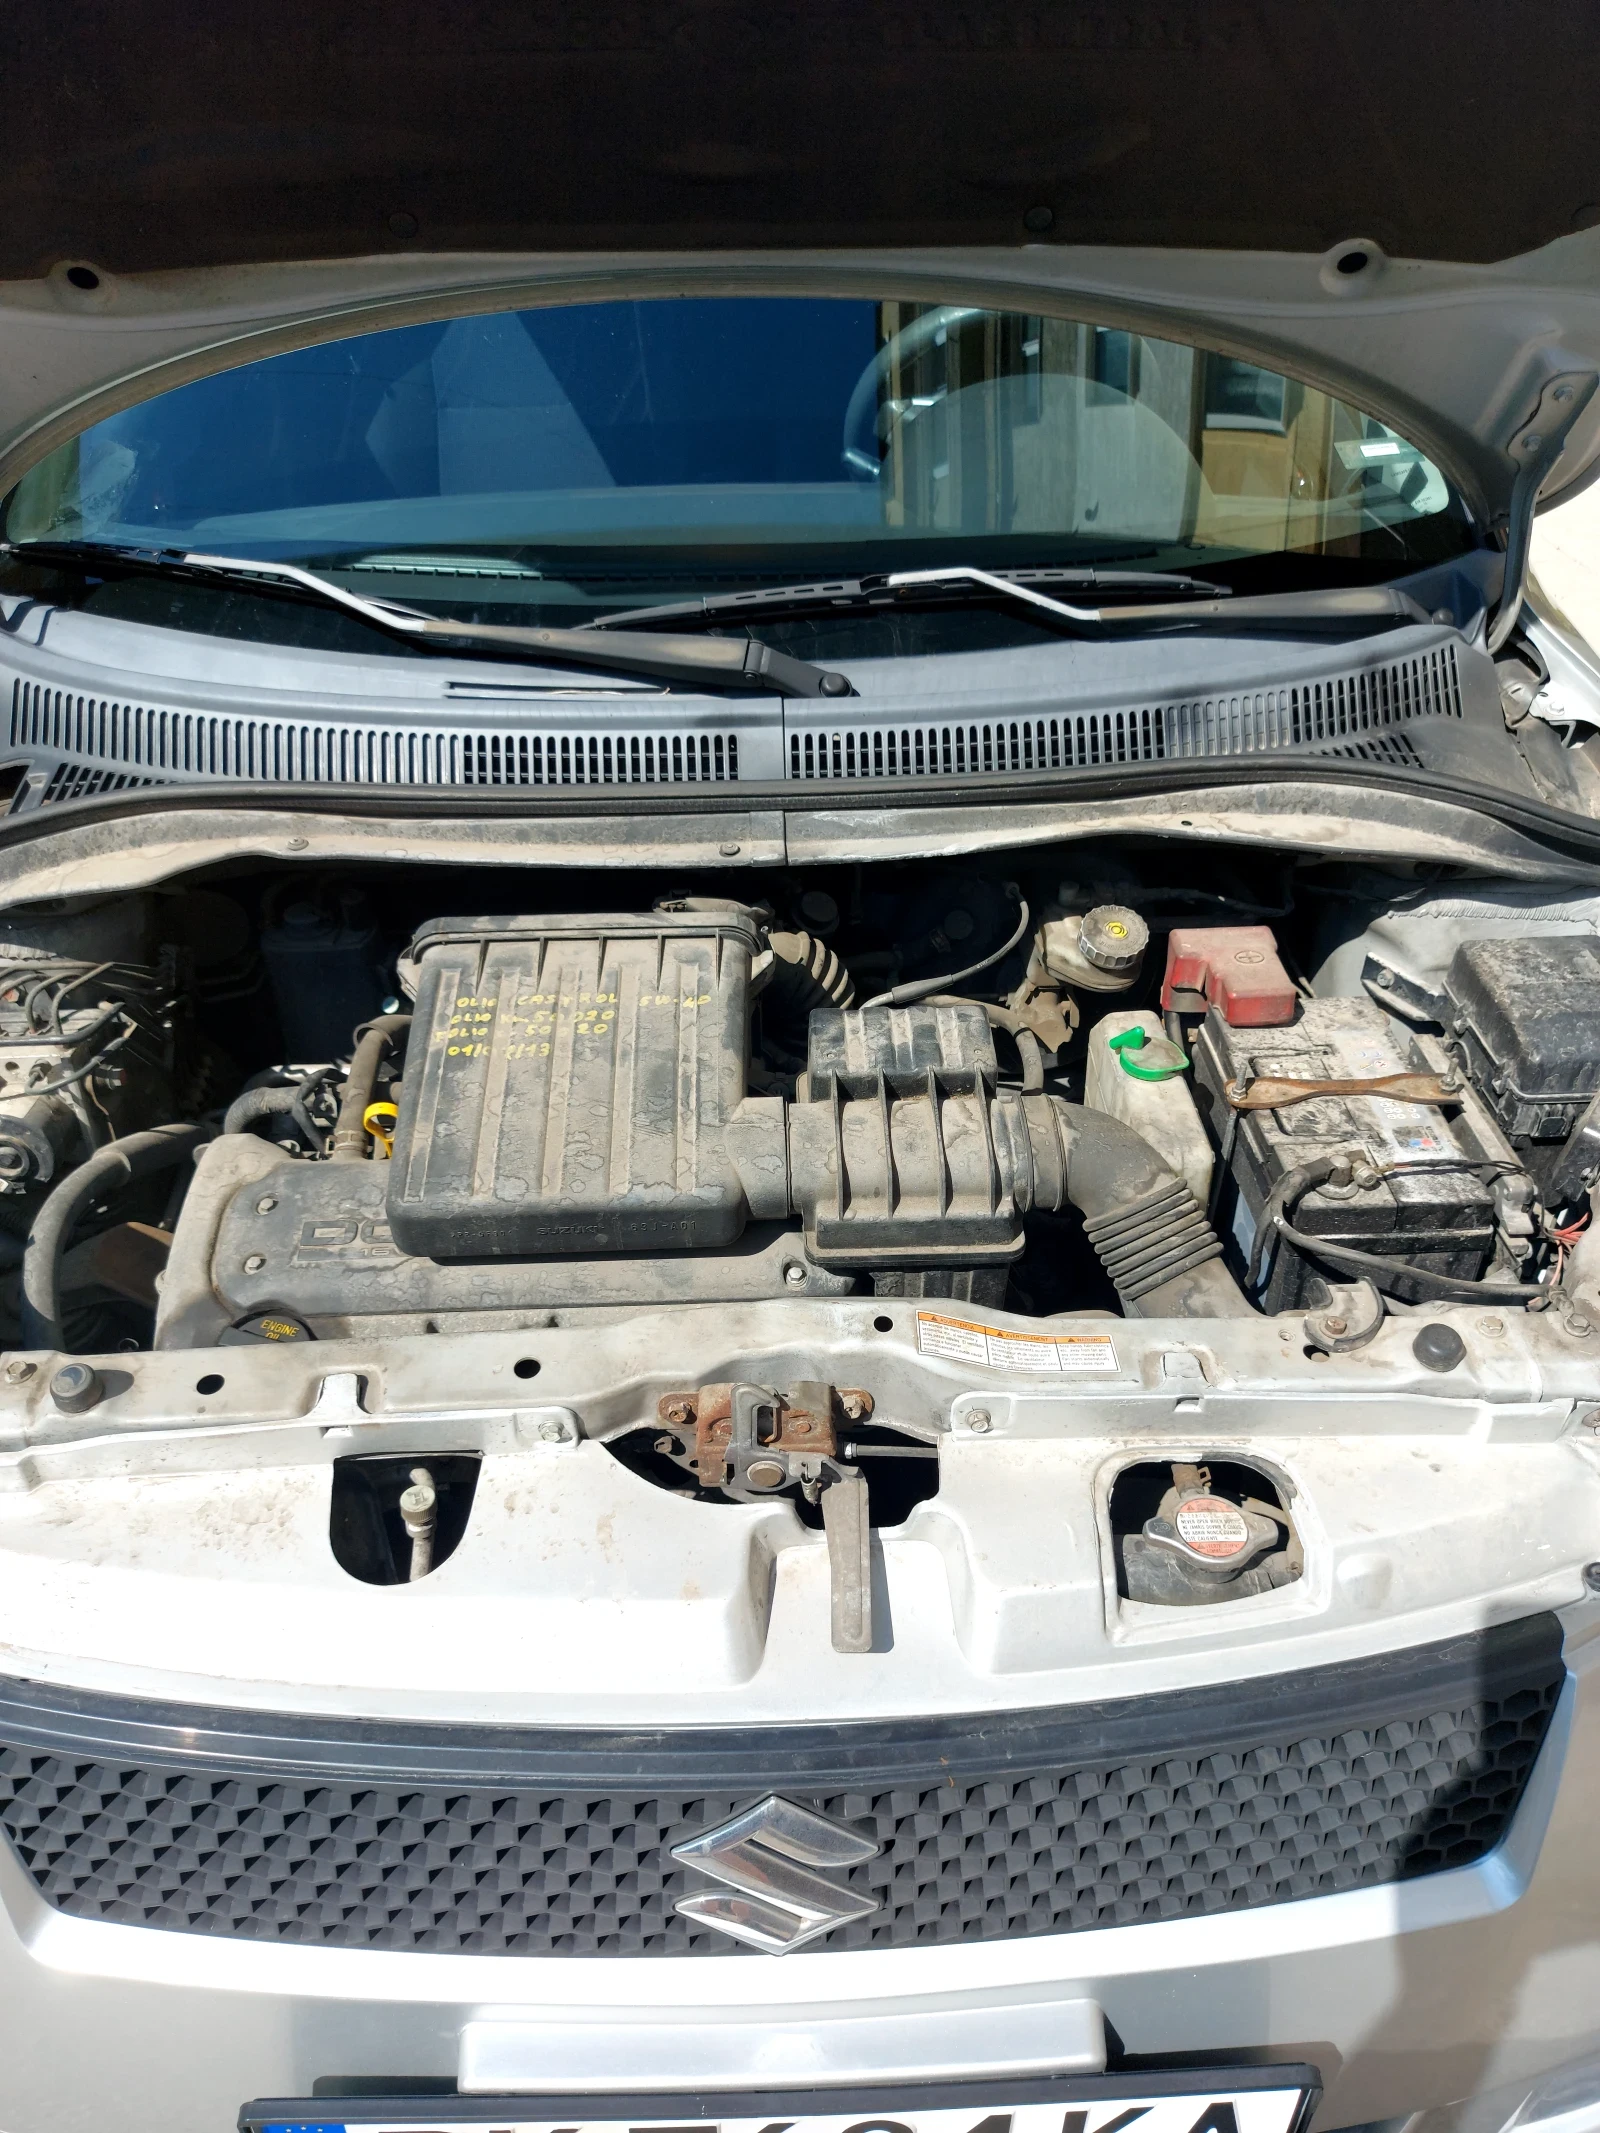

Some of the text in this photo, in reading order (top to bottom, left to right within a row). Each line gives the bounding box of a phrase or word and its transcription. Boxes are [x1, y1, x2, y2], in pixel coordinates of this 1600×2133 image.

[456, 997, 497, 1009] OLIO
[517, 994, 618, 1008] CASTROL
[536, 1223, 605, 1236] SUZUKI
[260, 1318, 300, 1337] ENGINE
